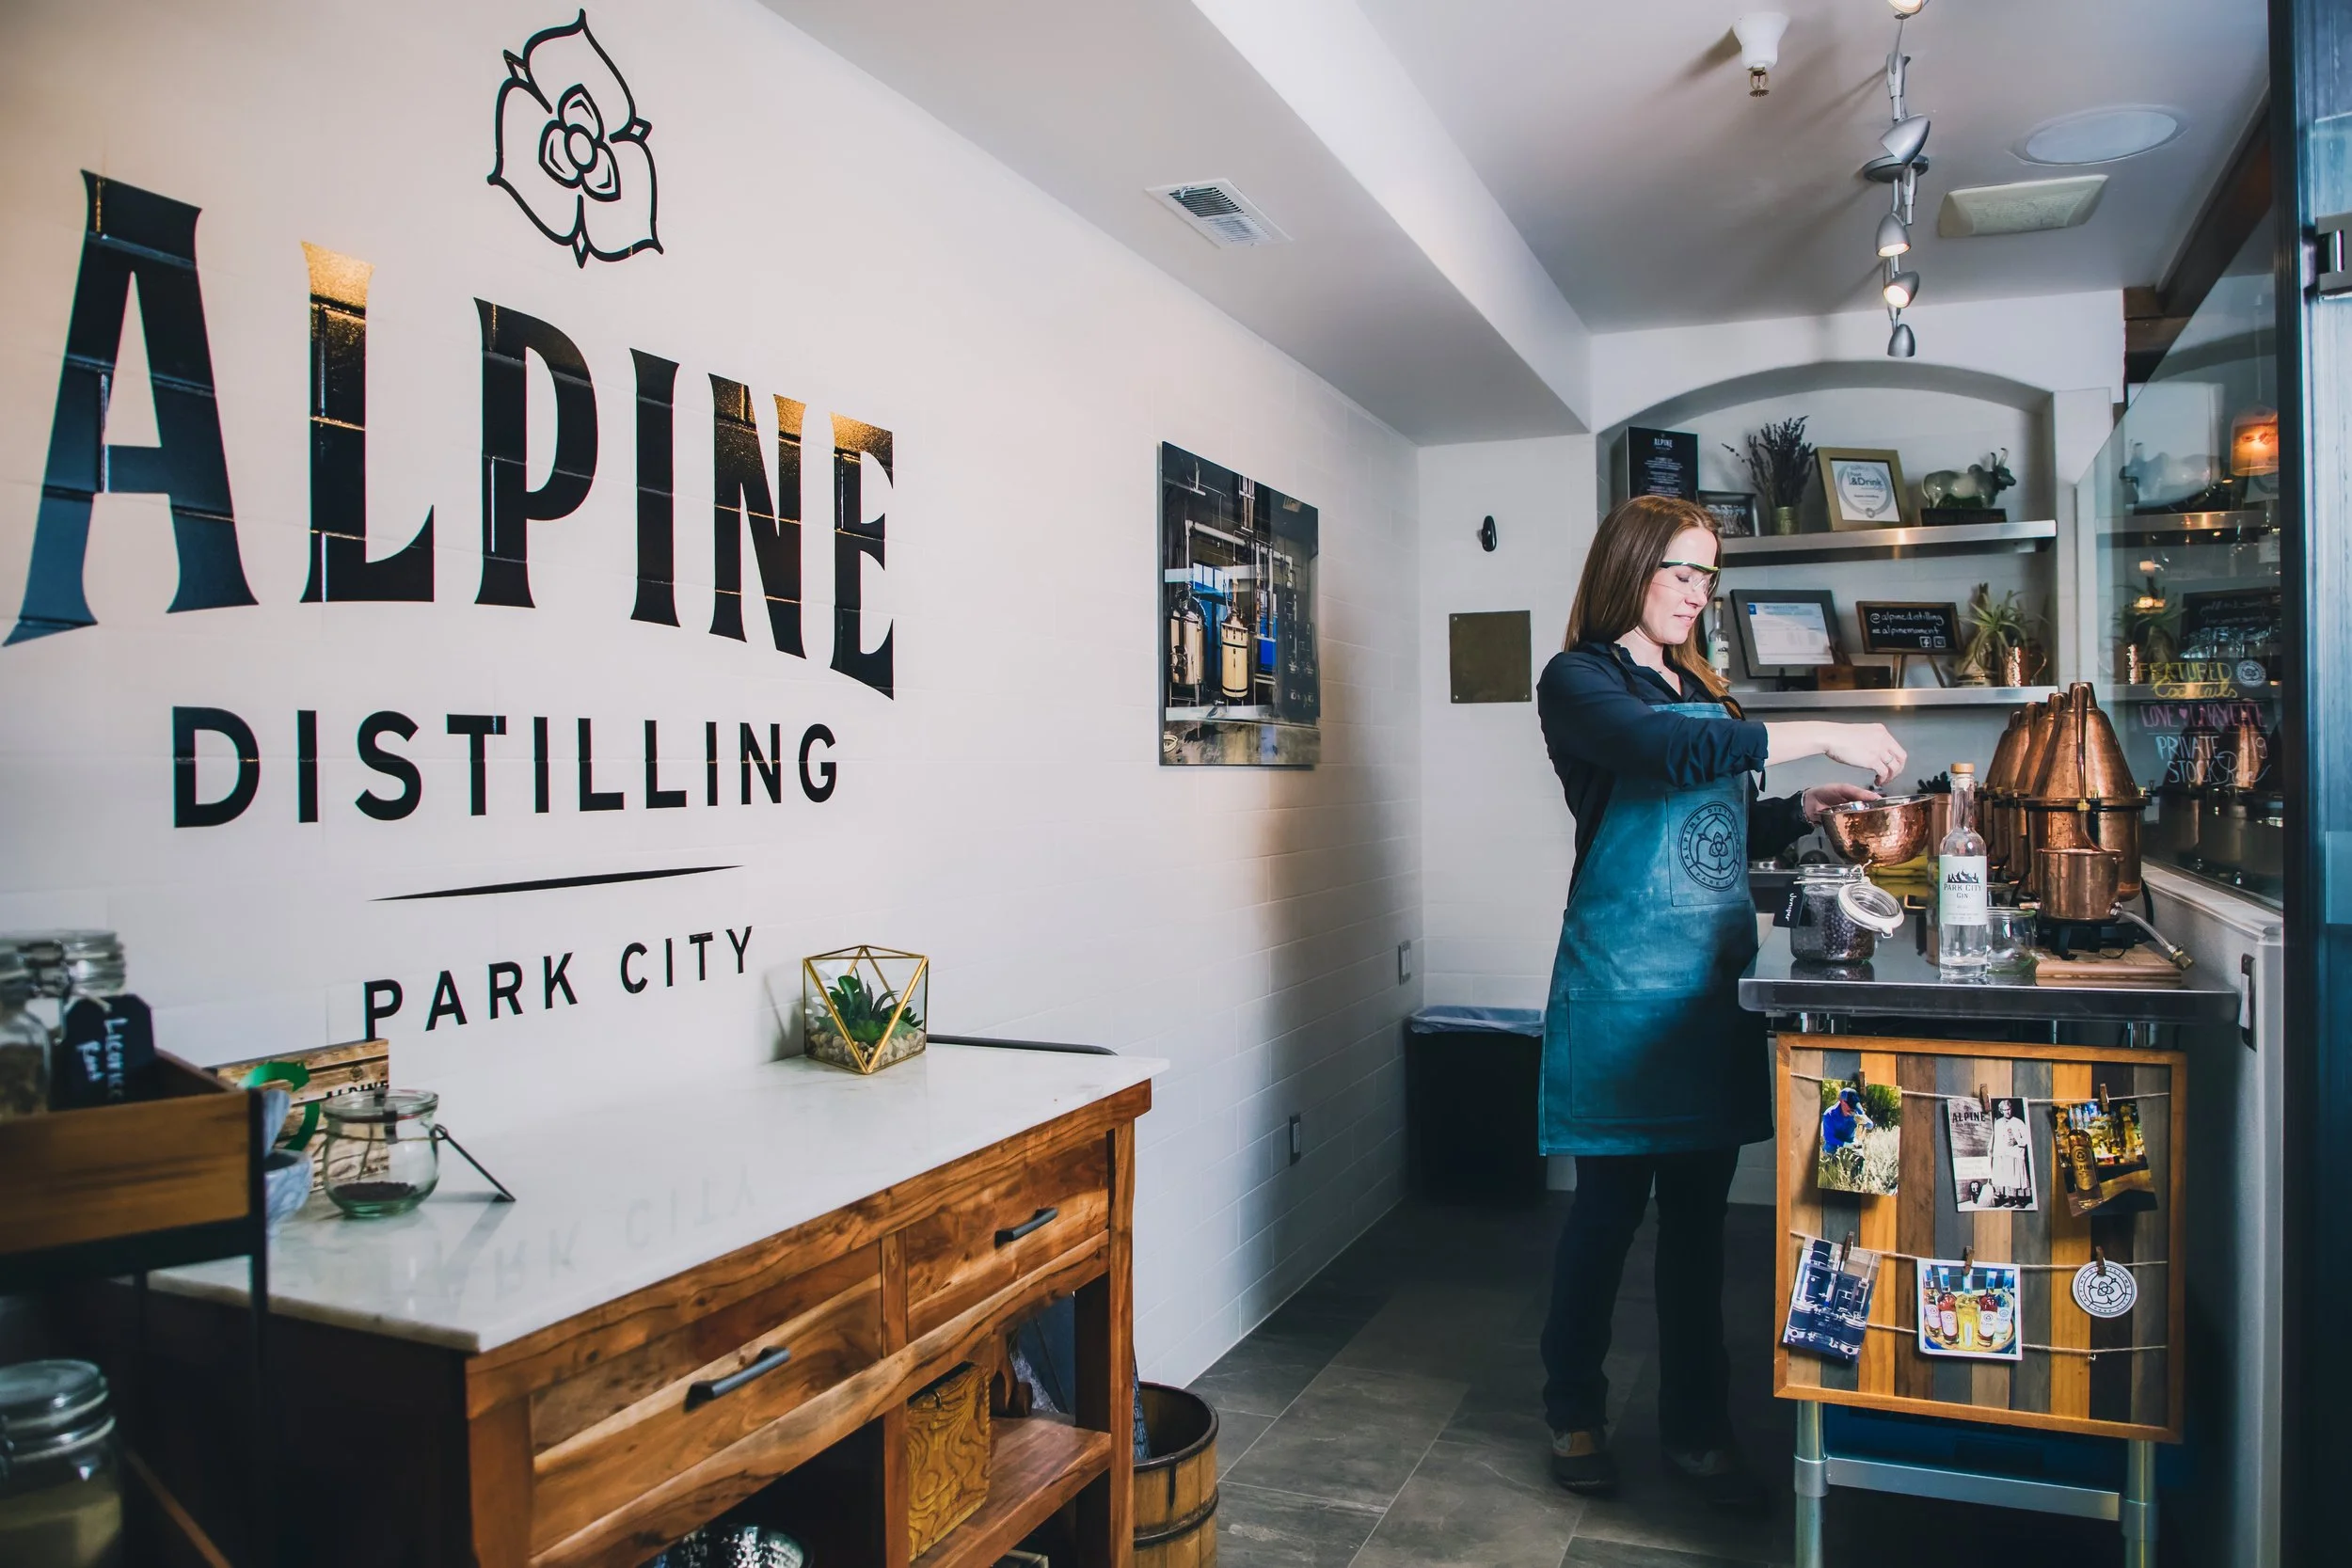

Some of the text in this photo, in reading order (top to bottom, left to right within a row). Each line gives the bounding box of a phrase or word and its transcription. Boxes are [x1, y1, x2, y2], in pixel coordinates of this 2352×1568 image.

[3, 168, 895, 701] ALPINE
[2137, 661, 2233, 682] FEATURED
[2140, 705, 2179, 728] LOVE
[2155, 736, 2220, 761] PRIVATE
[172, 705, 838, 829] DISTILLING
[2167, 758, 2219, 783] STOCK
[1682, 814, 1702, 860] ALPINE
[1944, 883, 1982, 892] PARK CITY
[363, 926, 754, 1040] PARK CITY
[1952, 1112, 1987, 1123] ALPINE
[2089, 1266, 2131, 1290] DIILLING
